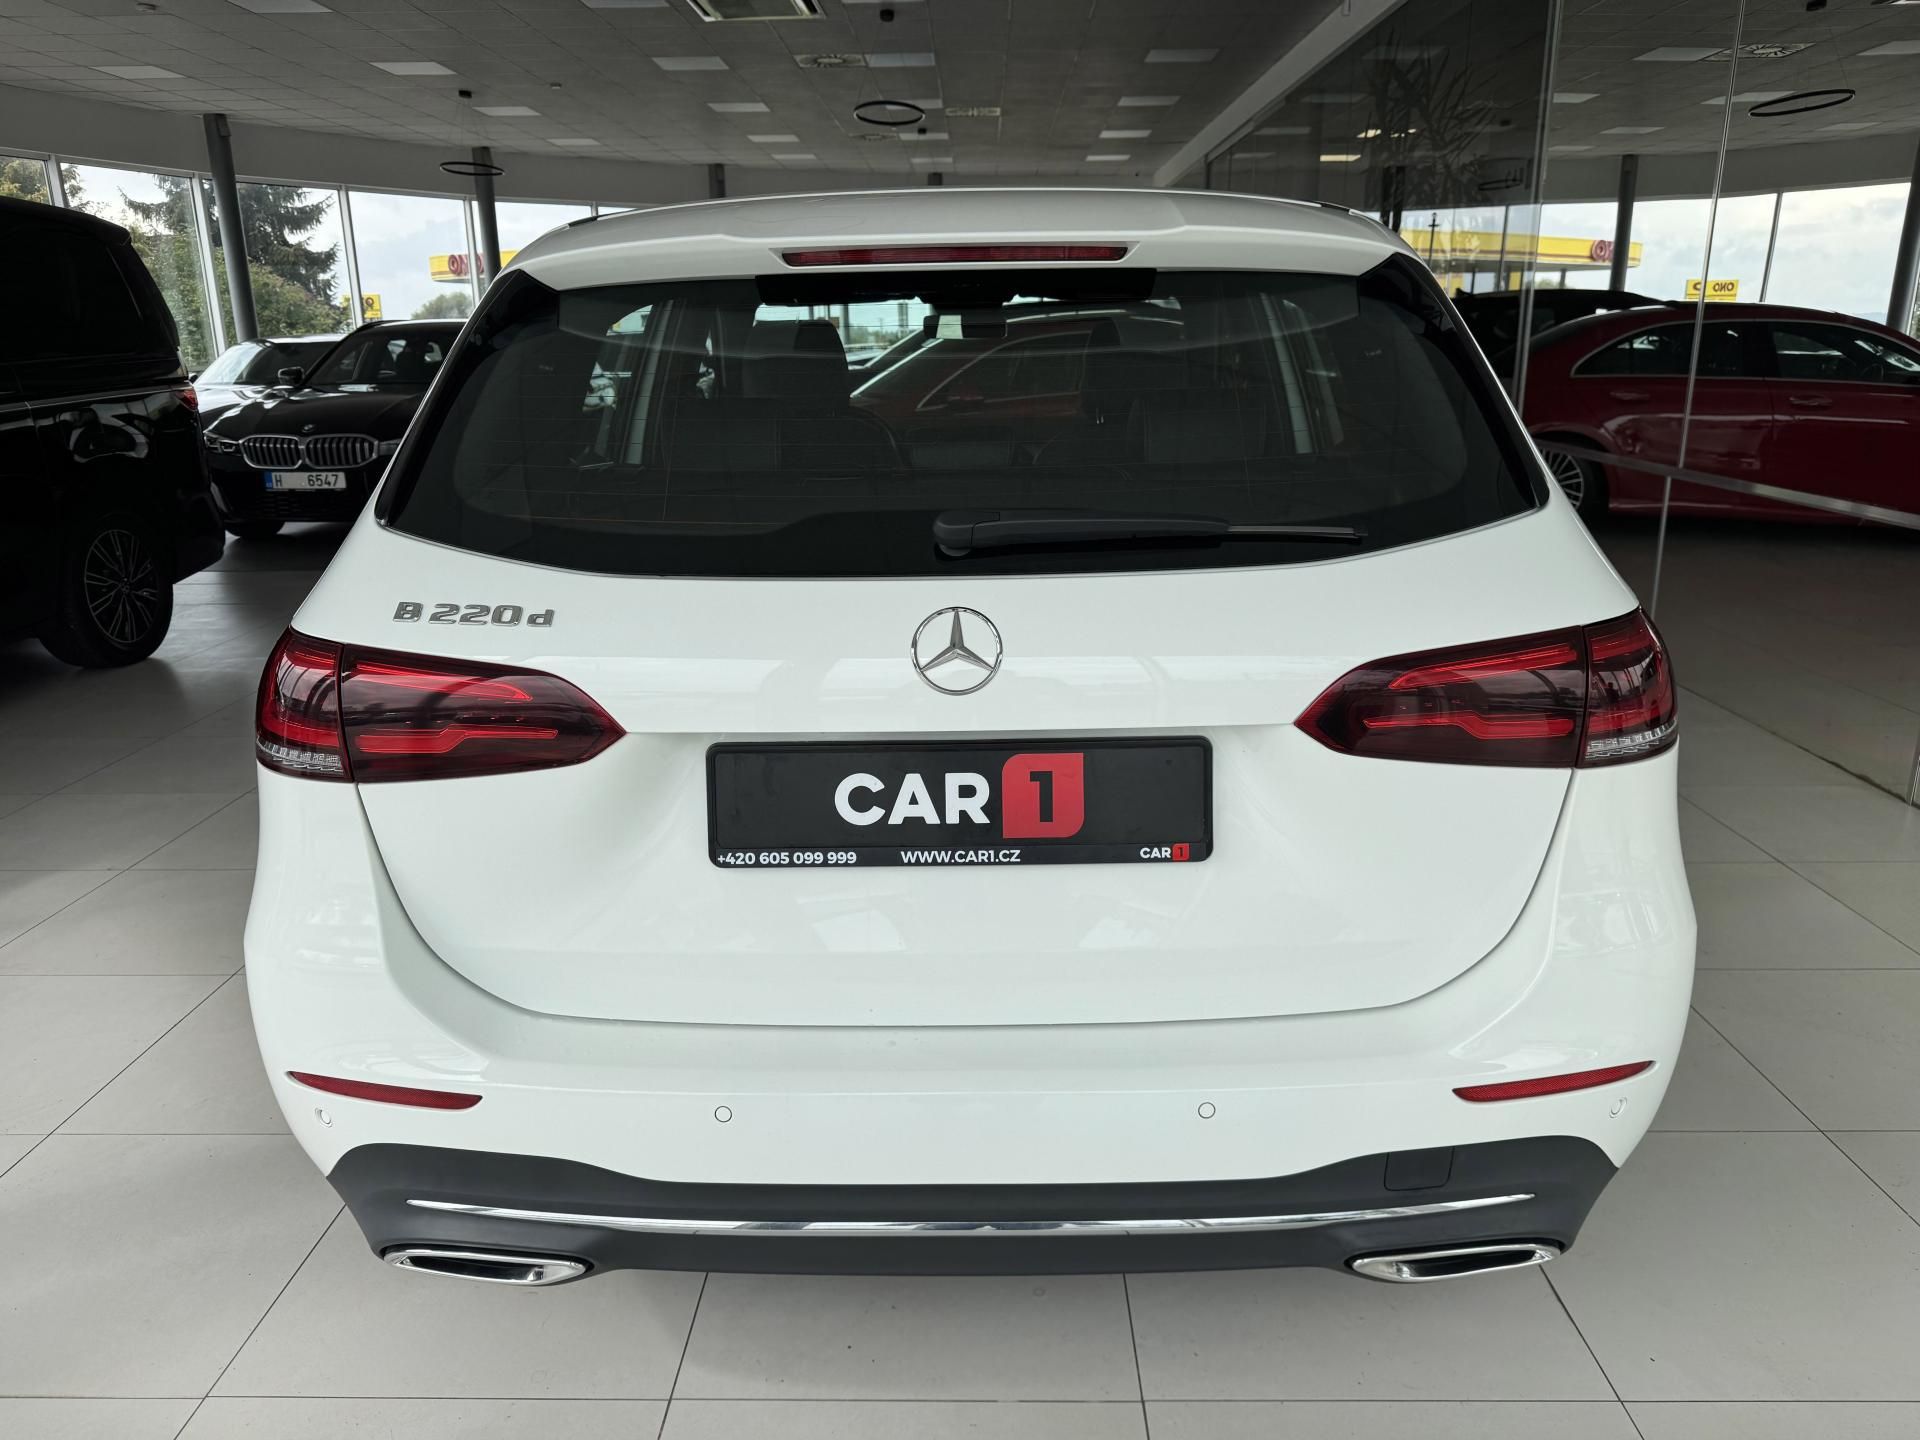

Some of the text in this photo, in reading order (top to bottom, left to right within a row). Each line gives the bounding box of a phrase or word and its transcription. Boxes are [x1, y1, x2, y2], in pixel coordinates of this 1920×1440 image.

[274, 473, 339, 488] H 6547
[393, 601, 555, 627] B 220 d
[834, 772, 991, 826] CAR
[717, 851, 857, 865] +420 605 099 999
[900, 849, 1021, 864] WWW.CAR1.CZ
